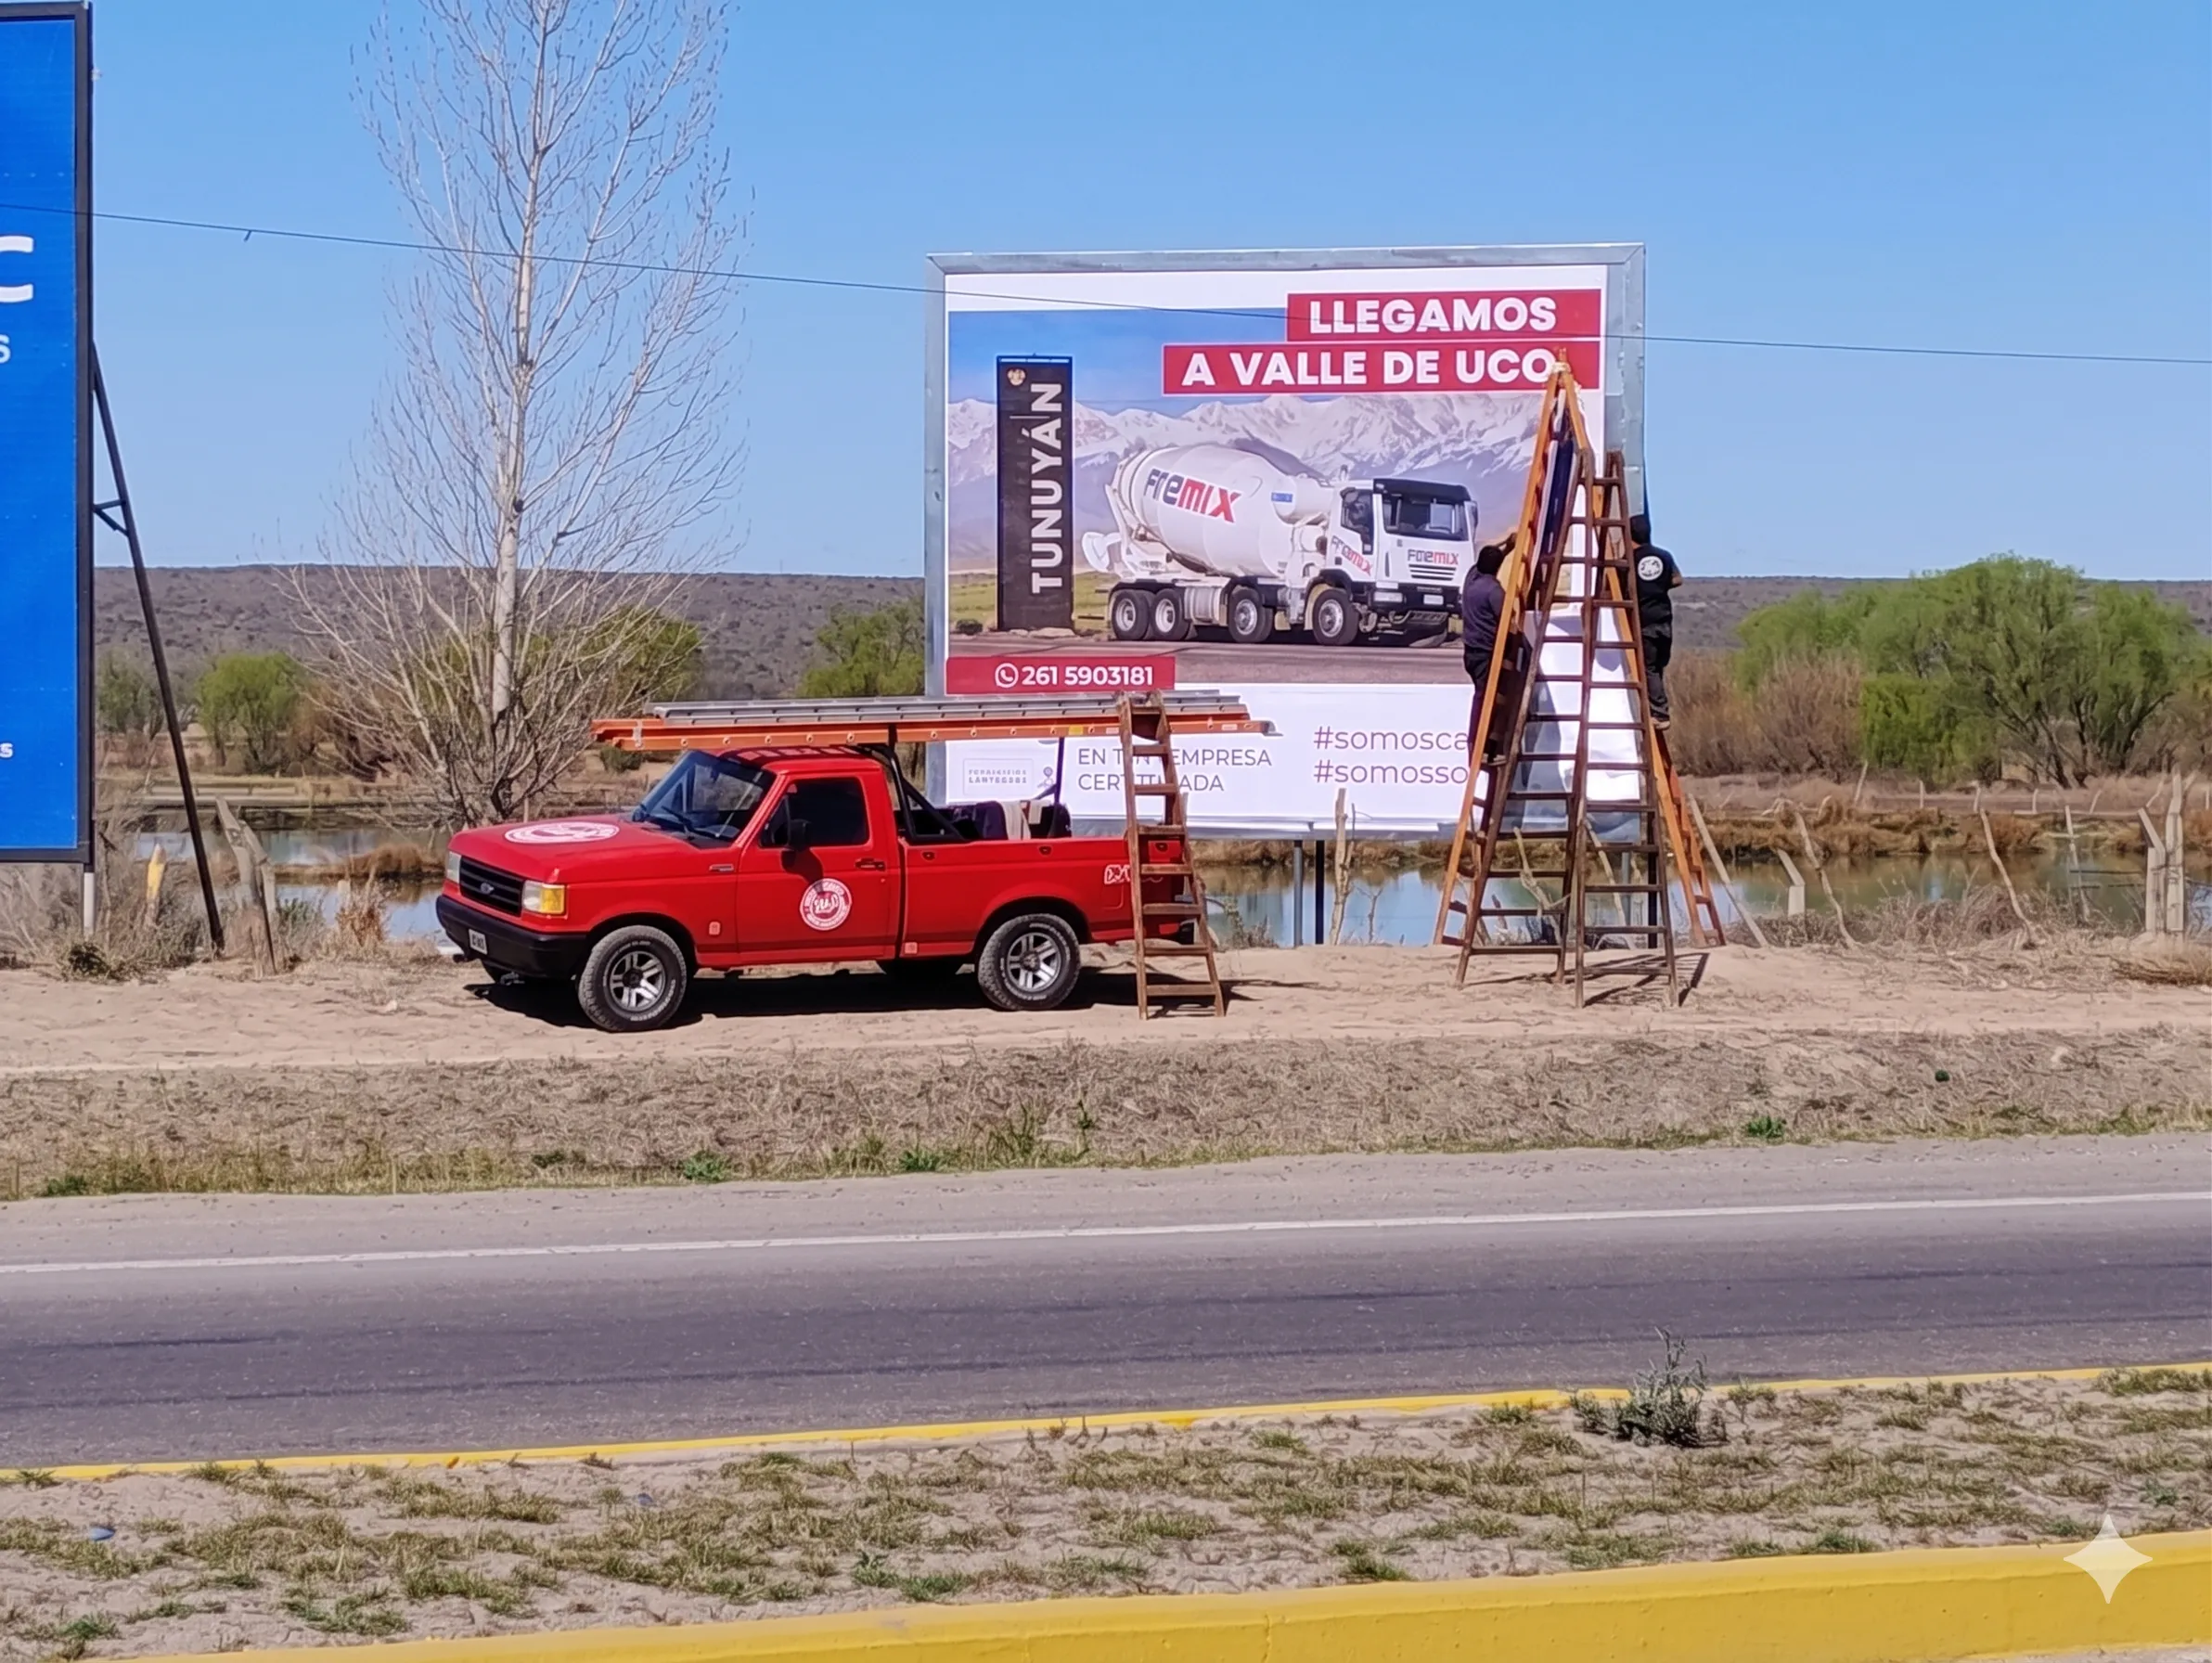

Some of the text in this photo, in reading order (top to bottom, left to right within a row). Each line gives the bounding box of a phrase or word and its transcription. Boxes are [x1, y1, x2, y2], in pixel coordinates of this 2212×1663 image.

[1309, 296, 1557, 334] LLEGAMOS
[1181, 347, 1555, 386] A VALLE DE UCO
[1022, 382, 1063, 594] TUNUYÁN
[1022, 665, 1153, 685] 261 5903181
[1313, 726, 1468, 751] #somosca
[1078, 748, 1106, 765] EN
[1171, 749, 1272, 767] EMPRESA
[1313, 759, 1469, 784] #somosso
